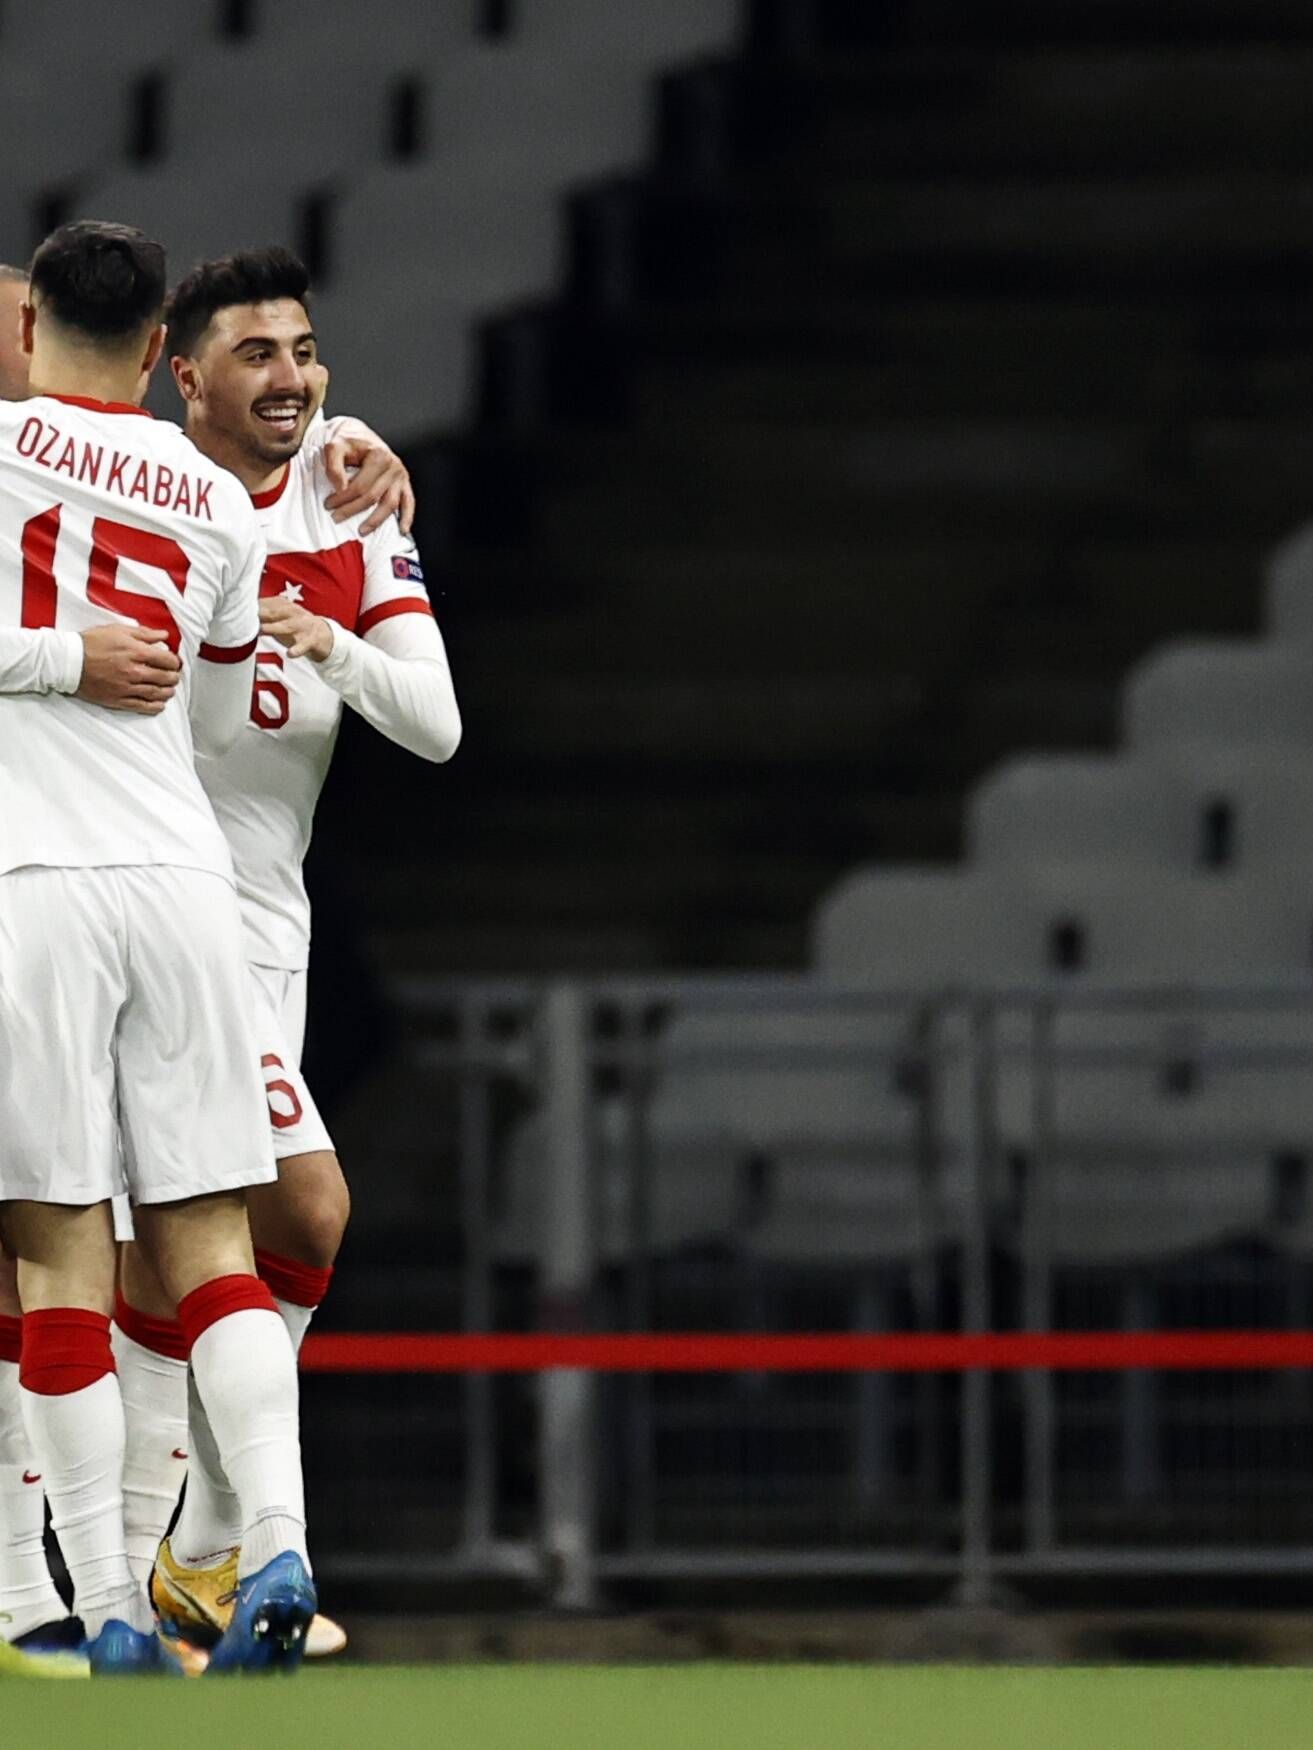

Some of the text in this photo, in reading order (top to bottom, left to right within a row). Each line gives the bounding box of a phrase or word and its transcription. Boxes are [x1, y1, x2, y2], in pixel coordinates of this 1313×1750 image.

[16, 417, 214, 522] OZAN KABAK
[250, 652, 290, 729] 6
[260, 1053, 303, 1129] 6
